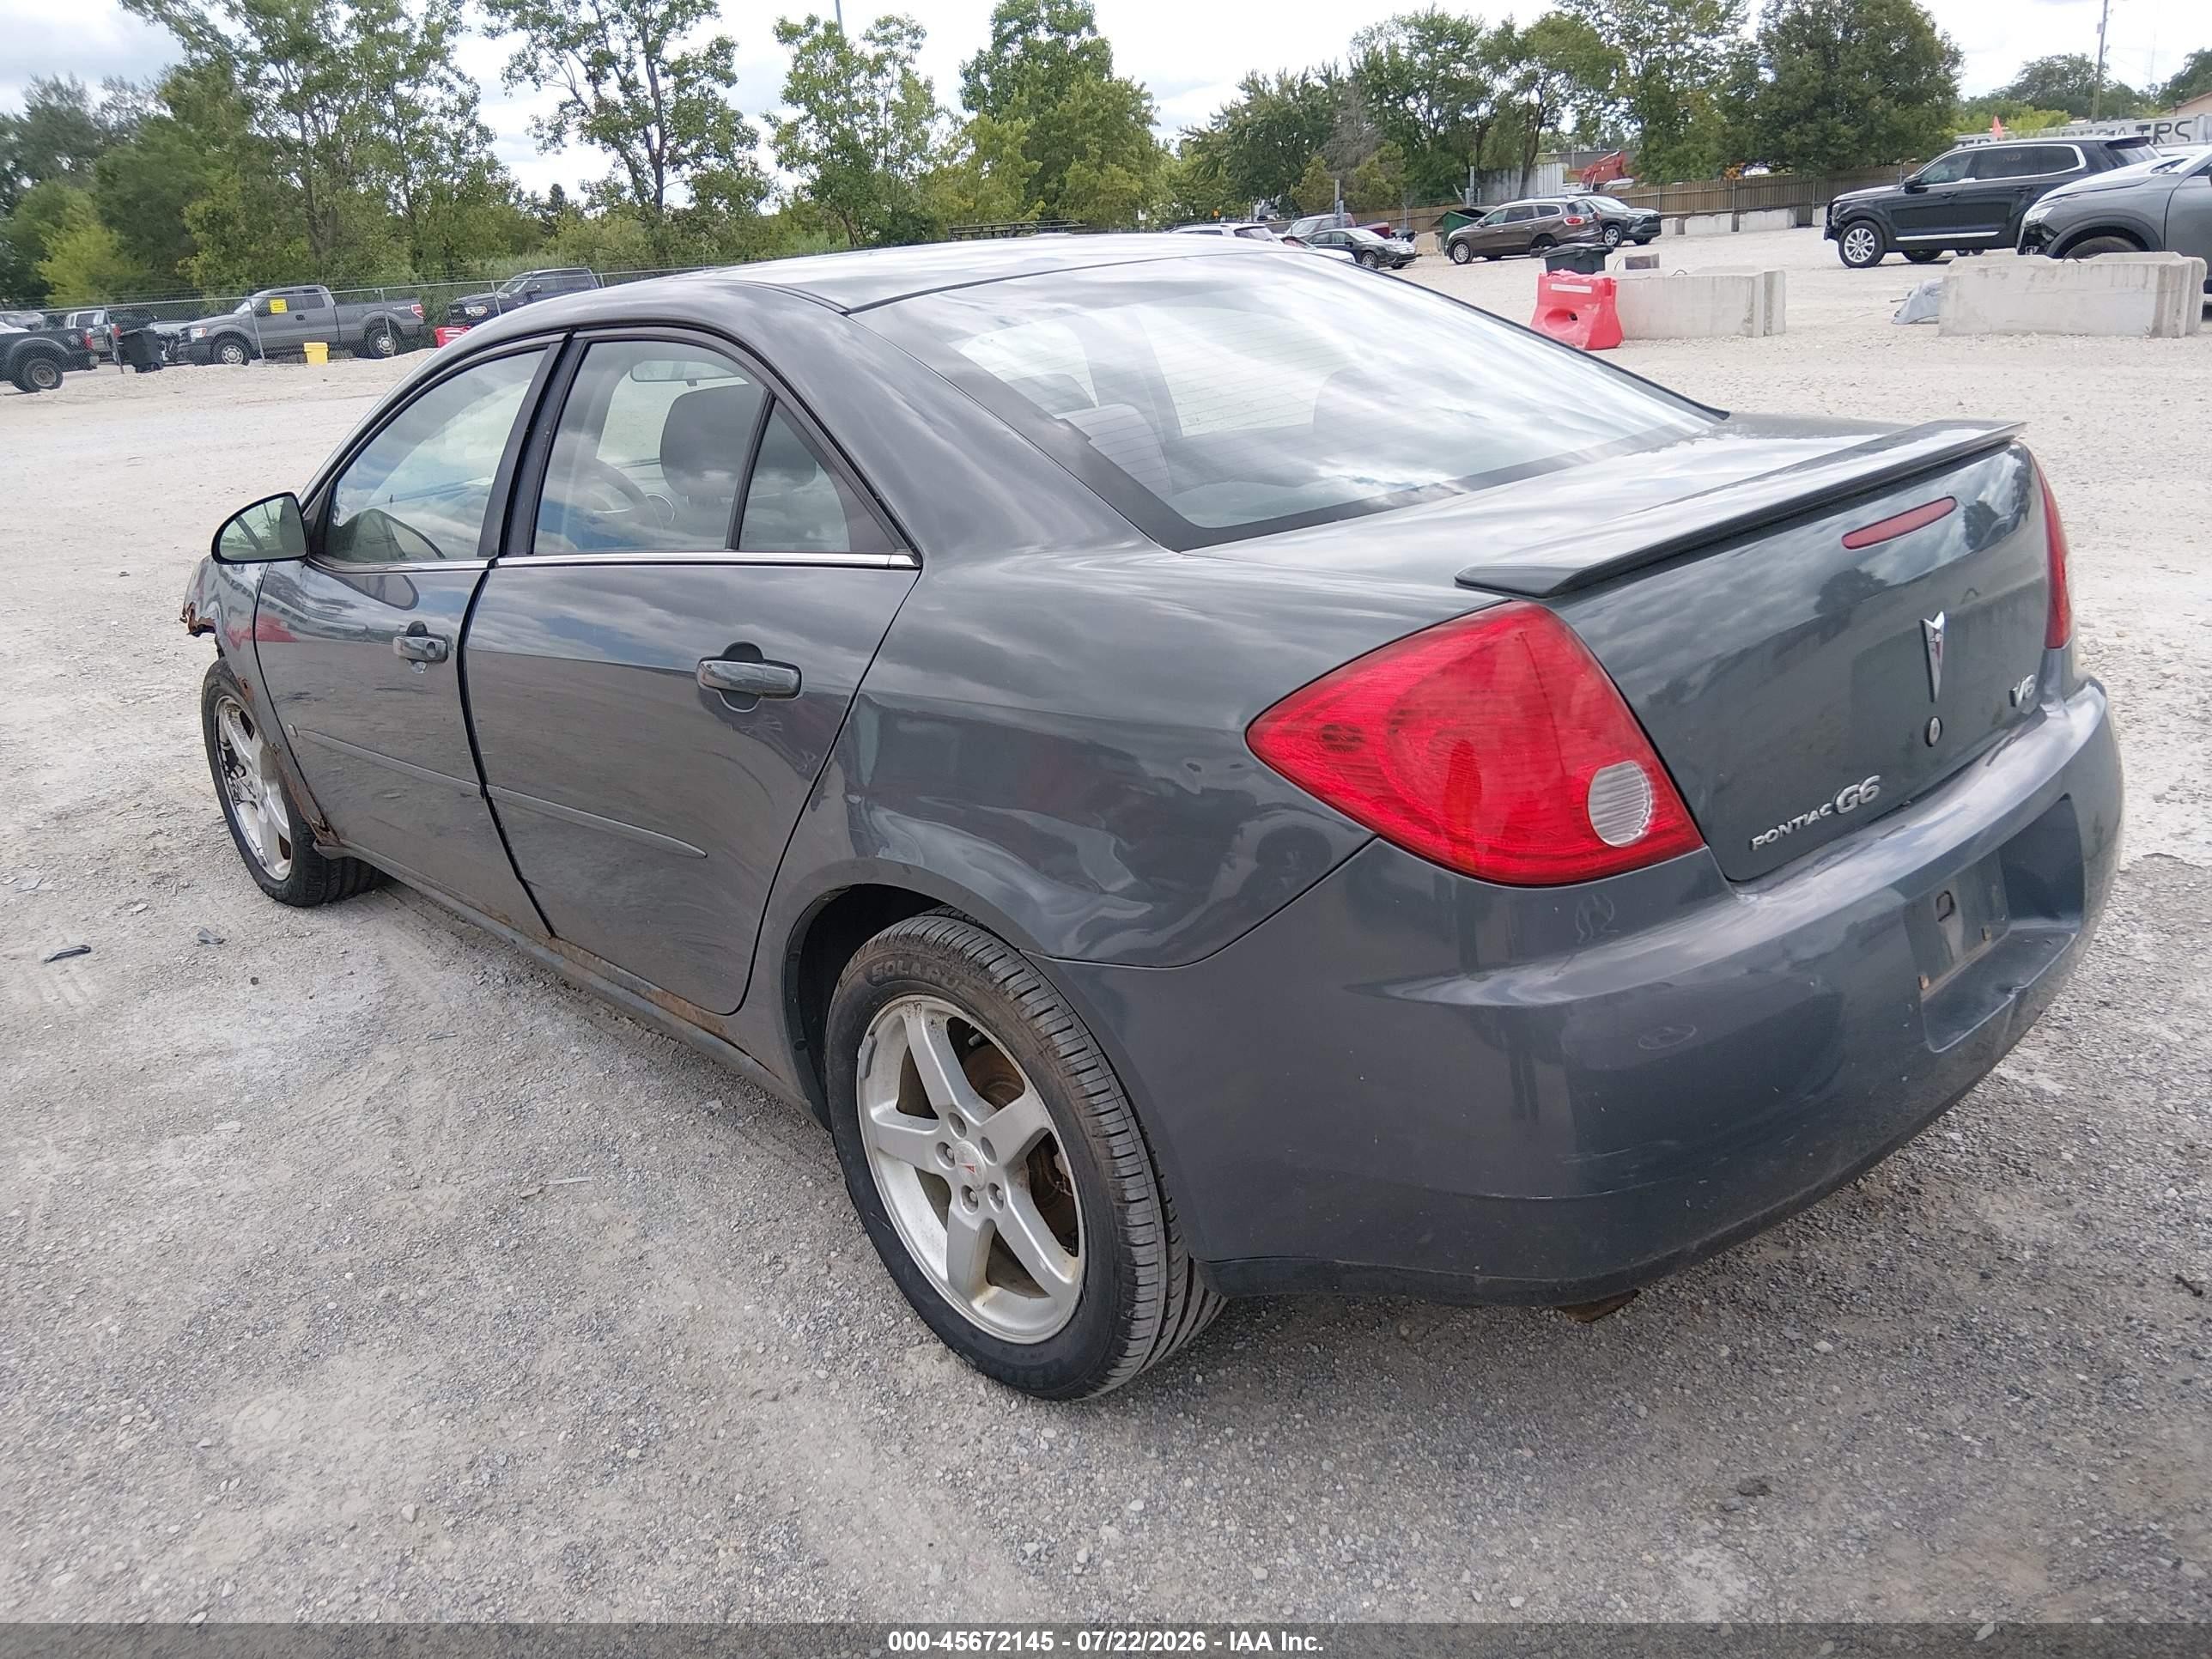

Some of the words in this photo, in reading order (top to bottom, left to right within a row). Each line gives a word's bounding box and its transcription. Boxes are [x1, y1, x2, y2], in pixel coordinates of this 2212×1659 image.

[2011, 674, 2035, 707] V6
[1750, 802, 1832, 851] PONTIAC
[1836, 775, 1881, 814] G6
